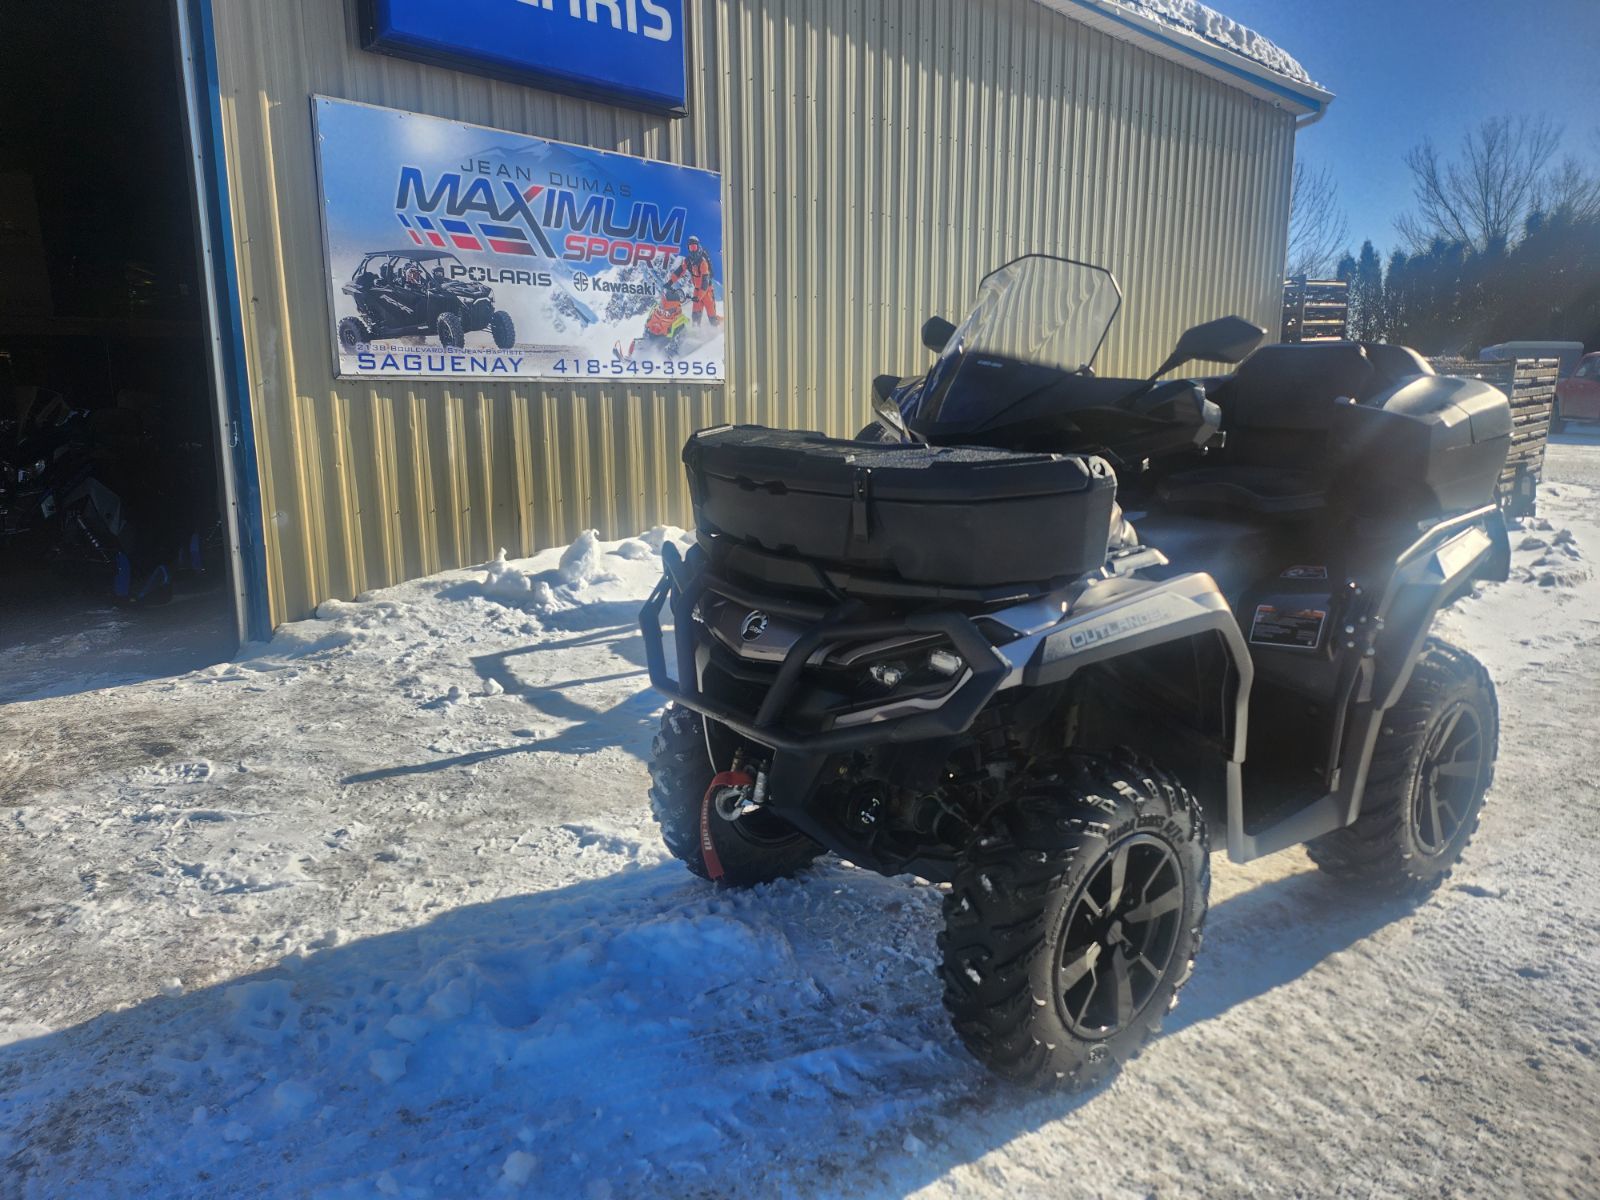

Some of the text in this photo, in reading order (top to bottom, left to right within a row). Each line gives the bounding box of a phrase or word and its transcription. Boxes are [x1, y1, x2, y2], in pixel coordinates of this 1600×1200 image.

[460, 158, 632, 198] JEAN DUMAS
[396, 166, 687, 258] MAXIMUM
[563, 236, 680, 270] SPORT
[450, 264, 552, 287] POLARIS
[592, 277, 656, 296] Kawasaki
[358, 352, 717, 375] SAGUENAY 418-549-3956
[1070, 607, 1170, 649] OUTLANDER
